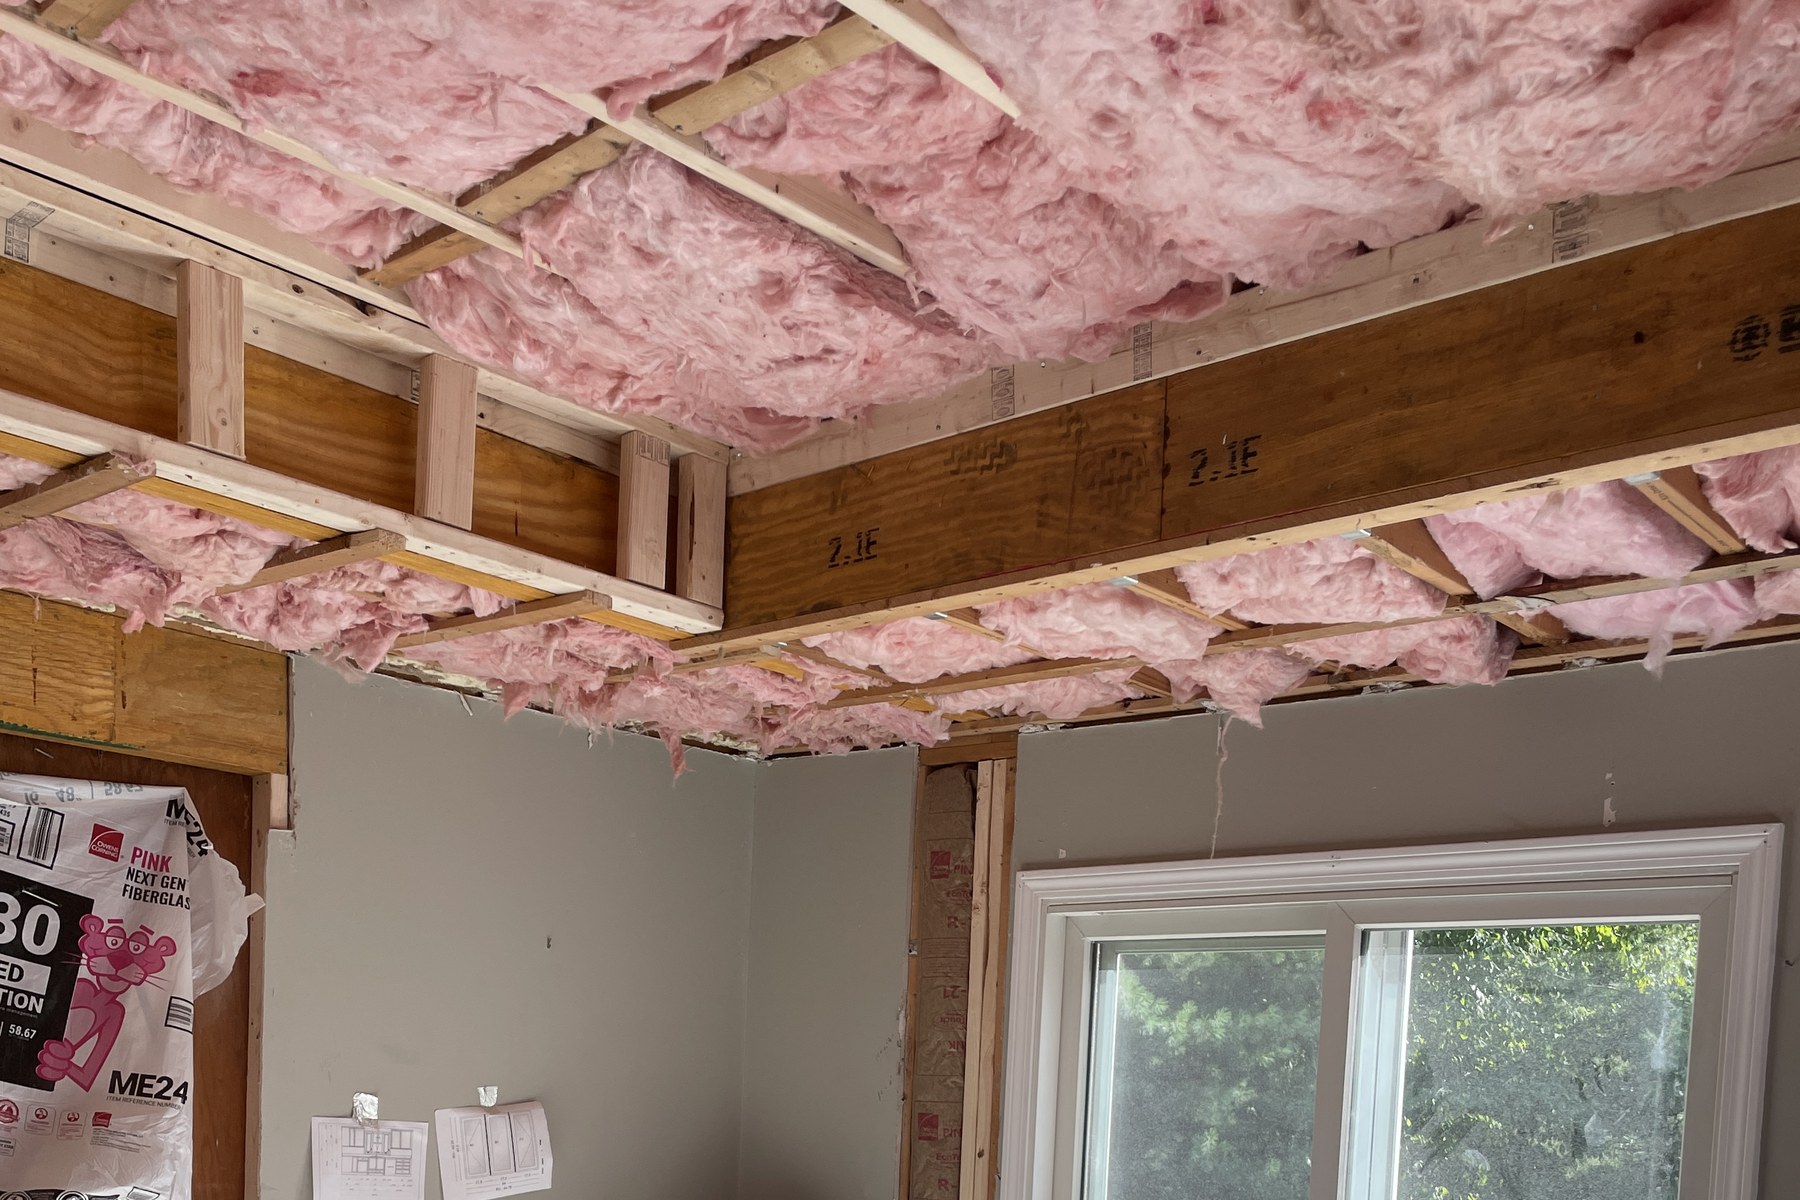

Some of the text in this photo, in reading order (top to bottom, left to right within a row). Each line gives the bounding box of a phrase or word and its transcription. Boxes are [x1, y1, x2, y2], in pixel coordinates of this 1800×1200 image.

[91, 844, 119, 859] CORNING
[97, 840, 120, 852] OWENS
[131, 846, 173, 873] PINK
[954, 864, 973, 875] PIN
[126, 867, 187, 891] NEXT GEN
[122, 883, 191, 910] FIBERGLAS
[9, 1023, 37, 1039] 58.67
[108, 1069, 189, 1105] ME24
[122, 1097, 157, 1107] REFERENCE
[157, 1102, 182, 1110] NUMBER
[943, 1128, 962, 1138] PIN
